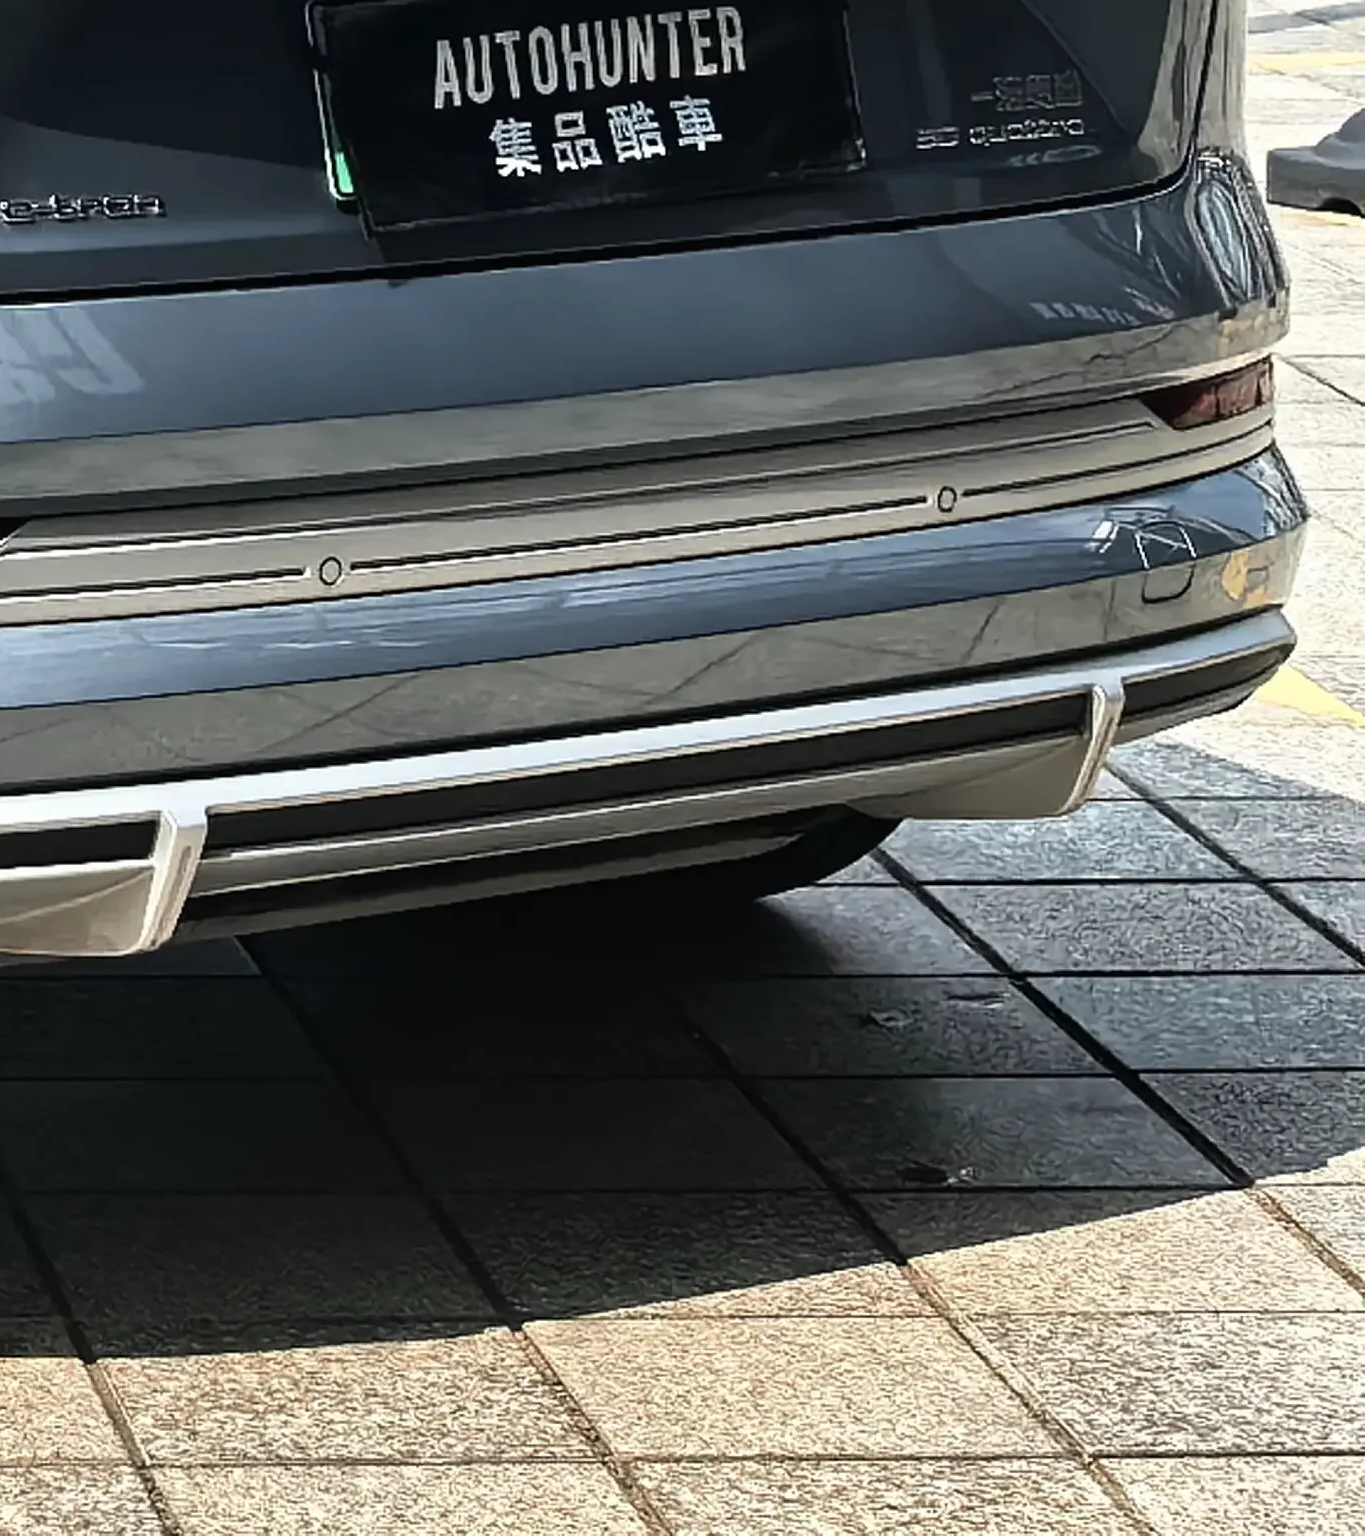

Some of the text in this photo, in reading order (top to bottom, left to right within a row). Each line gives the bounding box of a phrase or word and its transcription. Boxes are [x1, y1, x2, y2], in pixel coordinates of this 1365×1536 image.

[434, 6, 746, 109] AUTOHUNTER
[489, 95, 723, 177] 集品酷車
